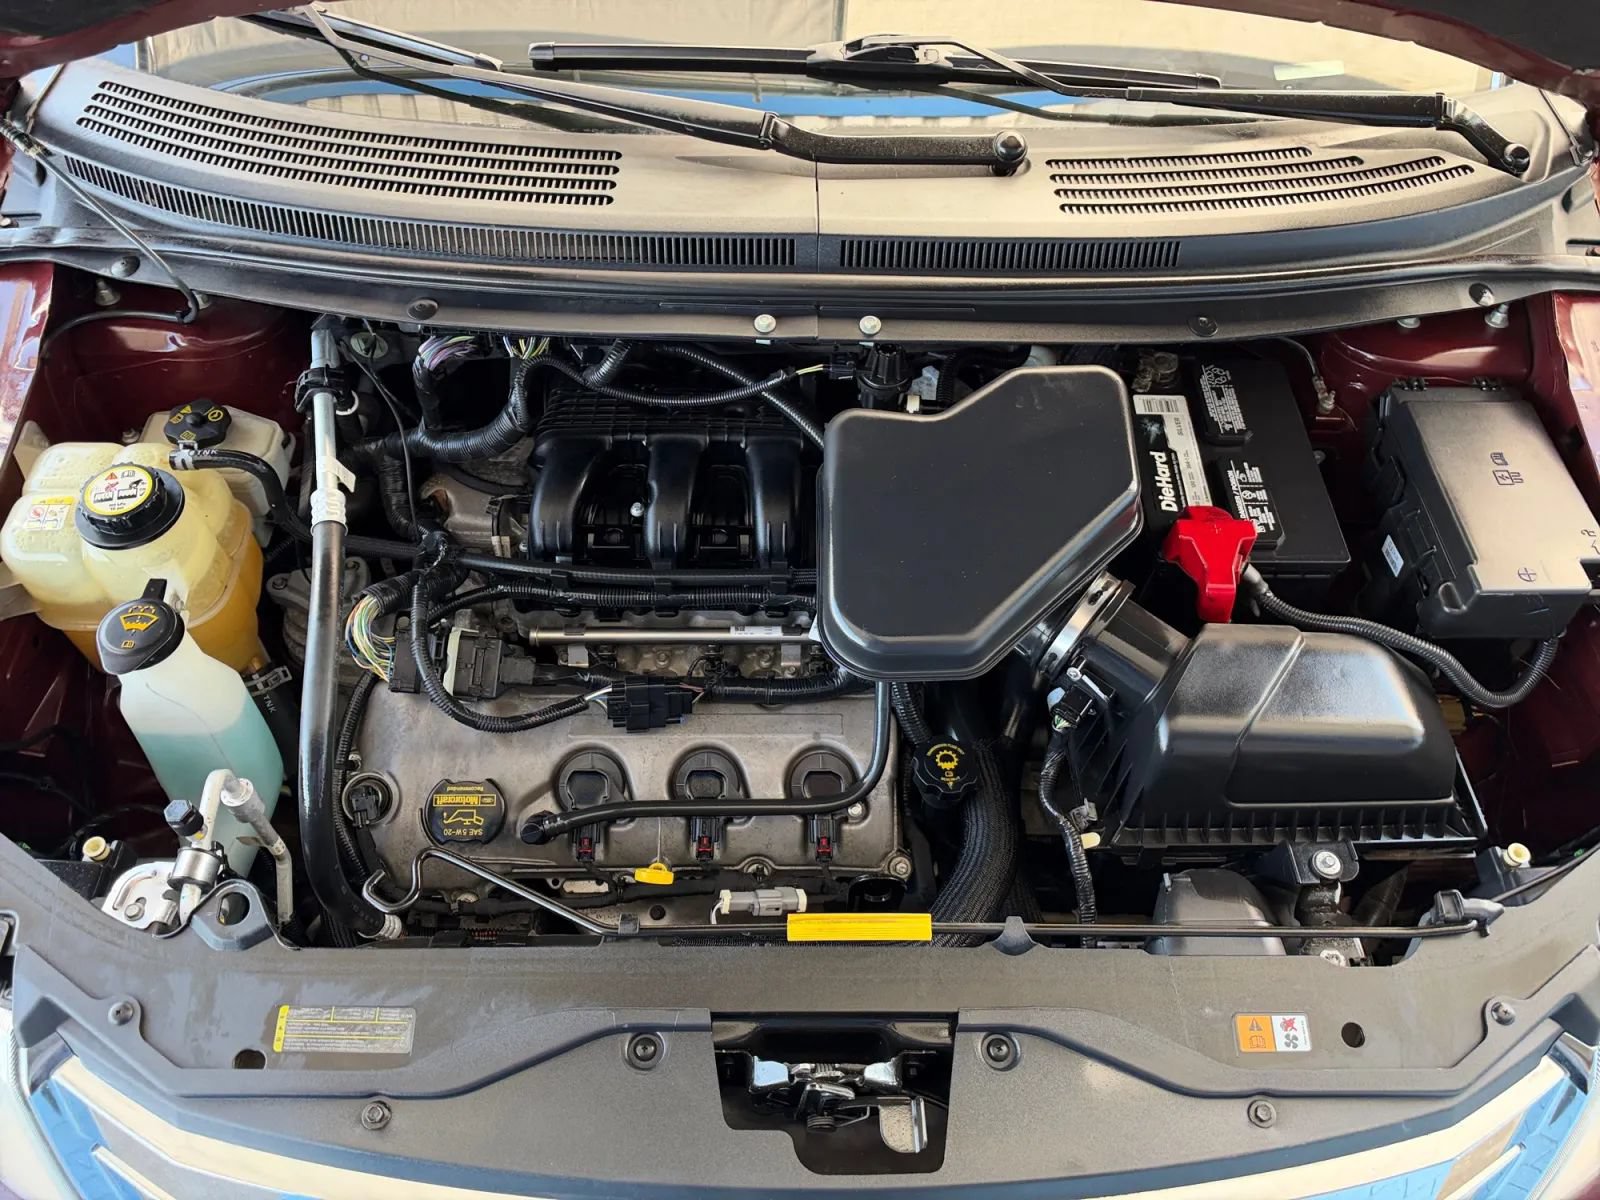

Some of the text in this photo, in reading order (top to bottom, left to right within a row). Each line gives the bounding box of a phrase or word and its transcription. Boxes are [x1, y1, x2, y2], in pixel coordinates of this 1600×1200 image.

[1173, 417, 1184, 436] SILVER
[1149, 450, 1179, 512] DieHard
[1227, 470, 1239, 490] POISON
[1234, 496, 1246, 519] DANGER
[436, 796, 479, 805] Motorcraft
[468, 828, 483, 836] SAE
